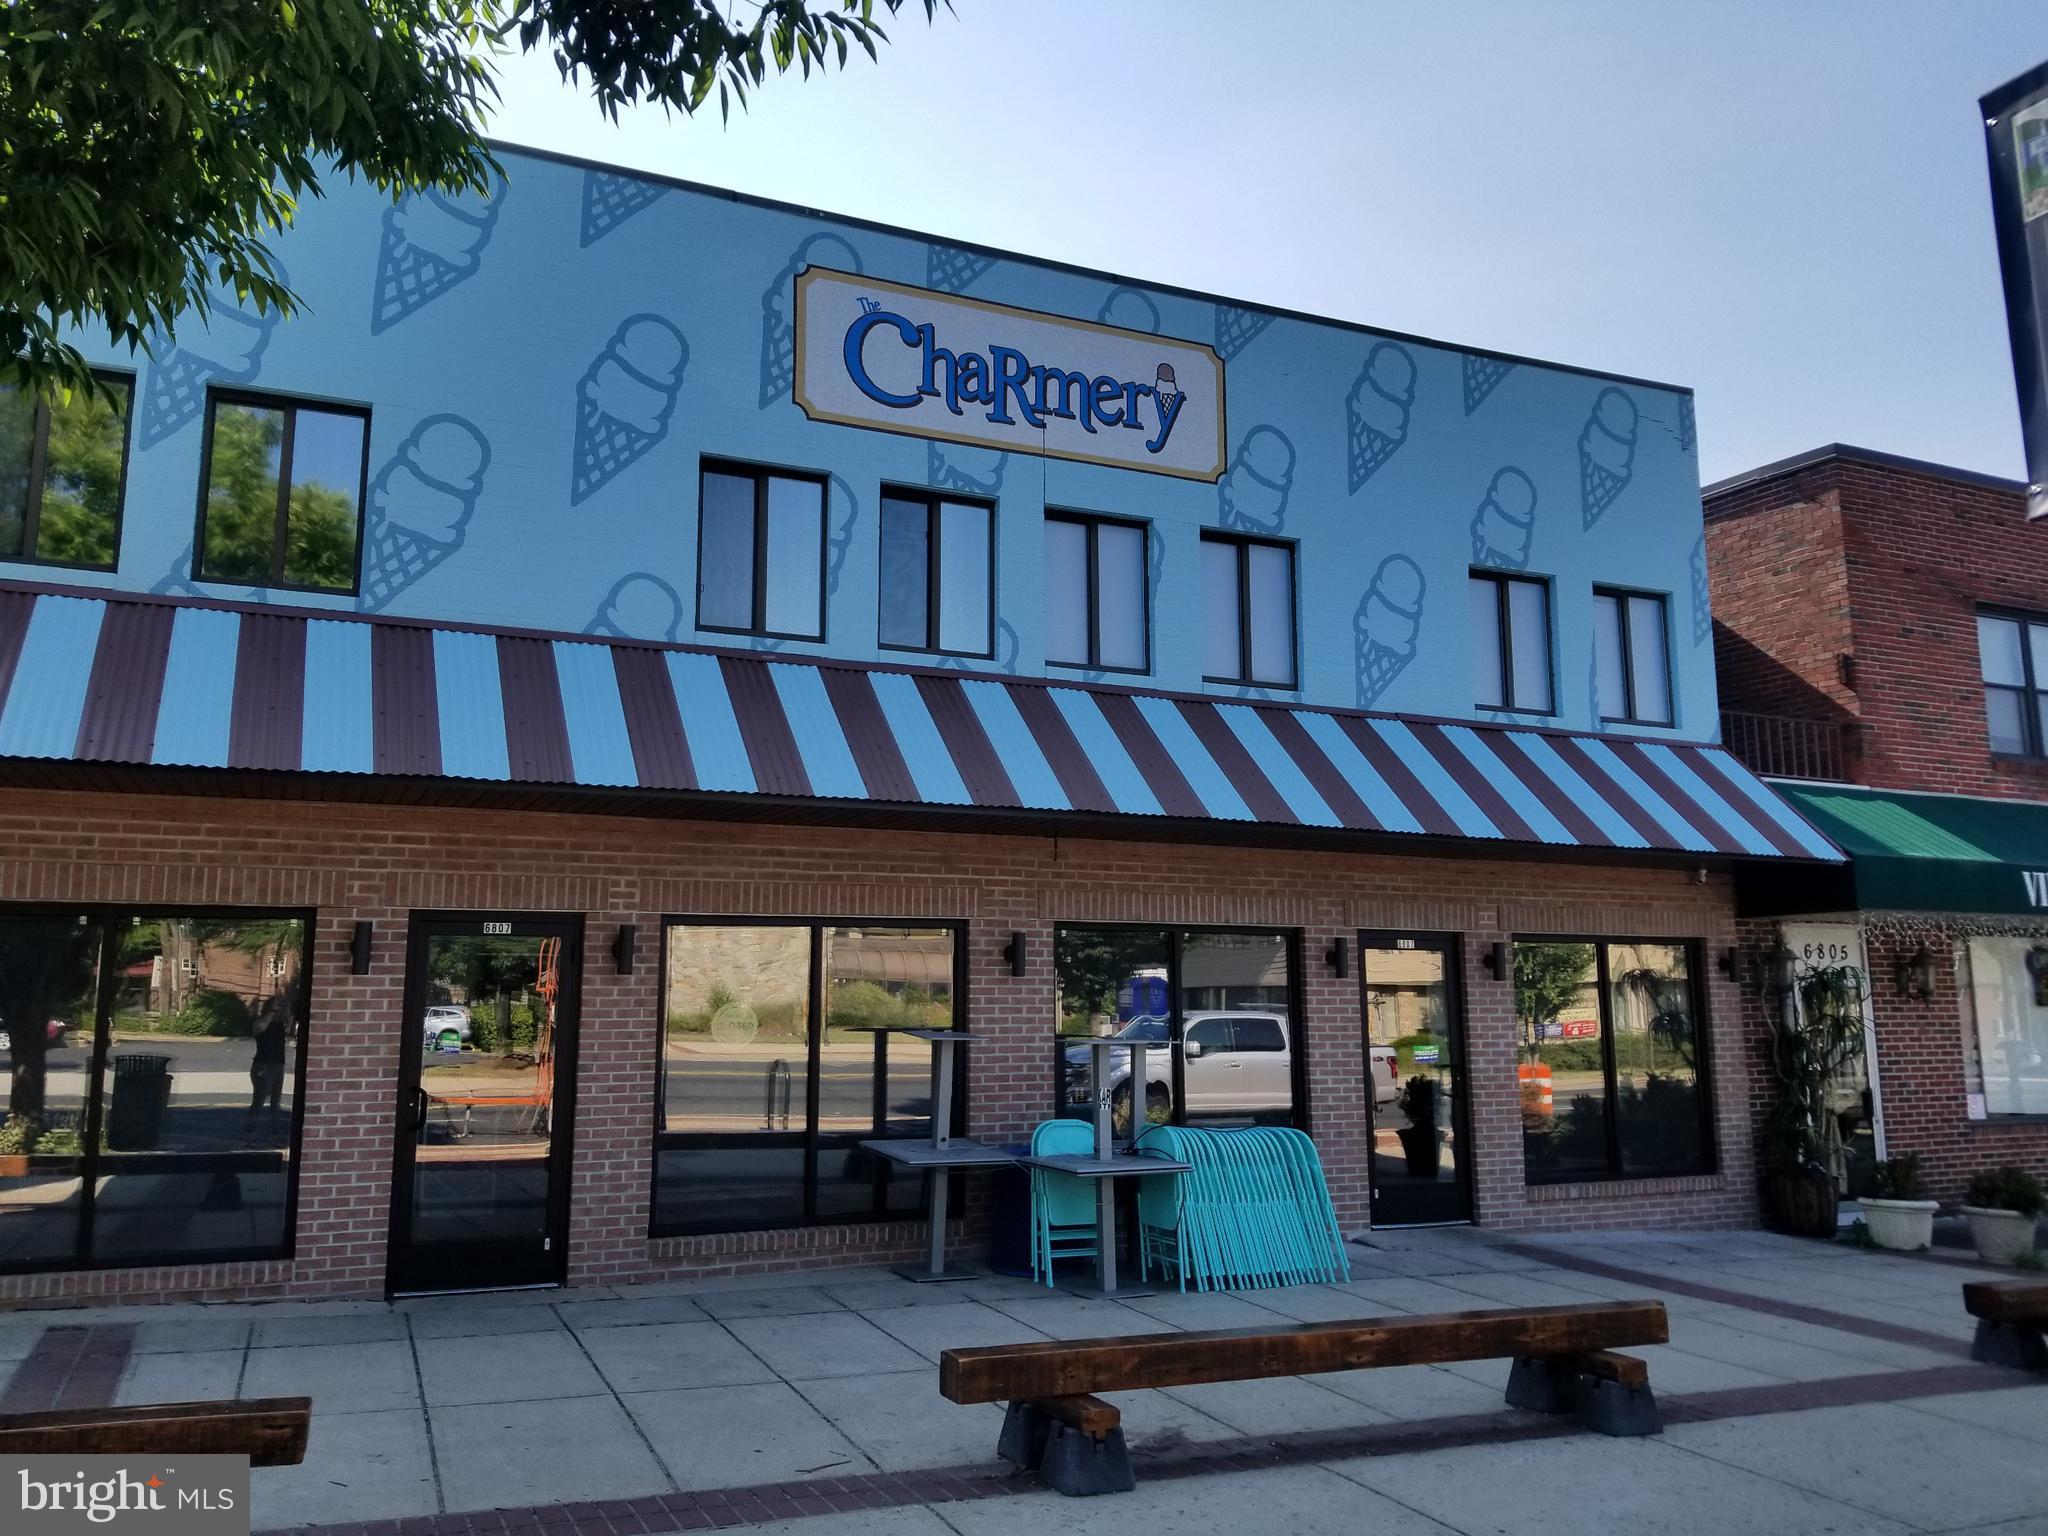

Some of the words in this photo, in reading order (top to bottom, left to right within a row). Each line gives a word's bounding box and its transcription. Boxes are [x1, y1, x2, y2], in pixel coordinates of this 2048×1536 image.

[856, 297, 881, 313] The
[484, 923, 511, 933] 6807
[1804, 943, 1848, 961] 6805
